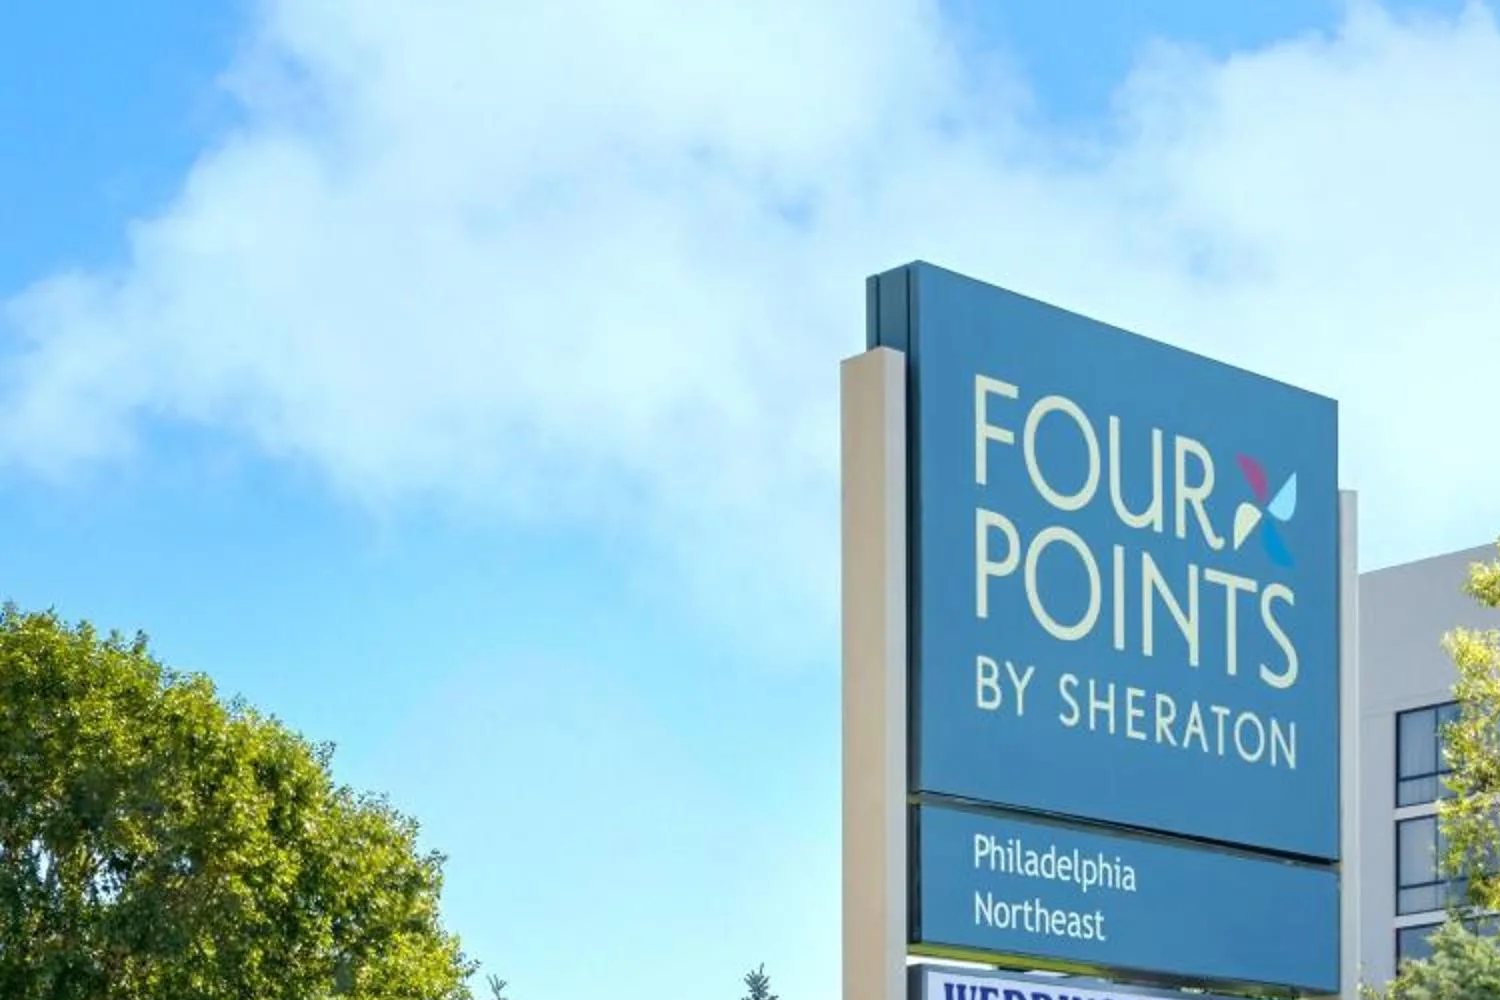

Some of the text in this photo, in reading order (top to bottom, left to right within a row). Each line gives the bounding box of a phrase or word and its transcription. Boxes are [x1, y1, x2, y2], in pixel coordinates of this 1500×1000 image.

[975, 374, 1226, 551] FOUR
[976, 507, 1299, 689] POINTS
[976, 655, 1297, 770] BY SHERATON
[974, 833, 1137, 893] Philadelphia
[974, 892, 1106, 941] Northeast
